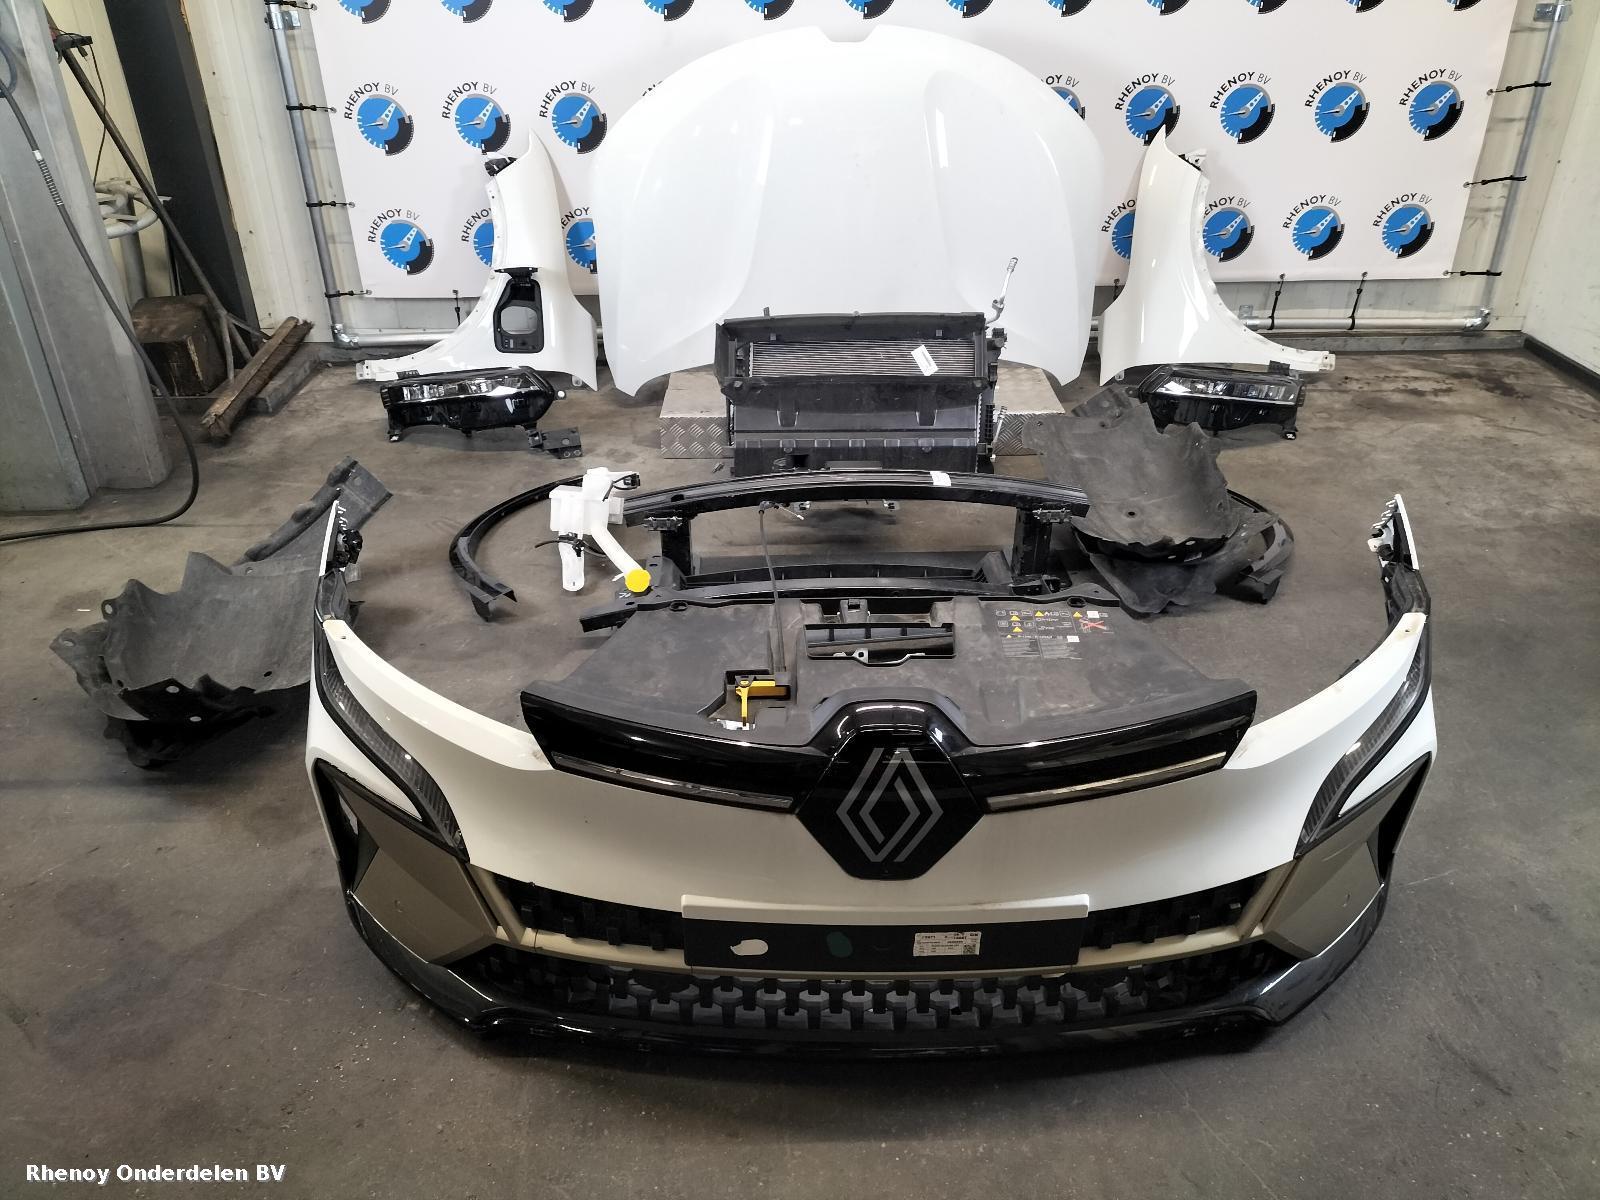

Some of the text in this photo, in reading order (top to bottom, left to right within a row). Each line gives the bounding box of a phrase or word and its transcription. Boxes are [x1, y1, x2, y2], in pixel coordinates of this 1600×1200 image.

[539, 80, 596, 118] RHENOY BV
[1065, 76, 1080, 87] BV
[1114, 73, 1176, 111] RHENOY BV
[1209, 72, 1271, 110] RHENOY BV
[1304, 70, 1367, 108] RHENOY BV
[1398, 69, 1463, 106] RHENOY BV
[343, 82, 399, 120] RHENOY BV
[441, 81, 498, 119] RHENOY BV
[367, 208, 420, 244] RHENOY BV
[461, 207, 491, 243] RHENO
[561, 206, 590, 230] ENOY
[1101, 200, 1136, 233] RHENO
[1203, 196, 1251, 221] ENOY BV
[1282, 195, 1341, 229] RHENOY BV
[1373, 193, 1432, 228] RHENOY BV
